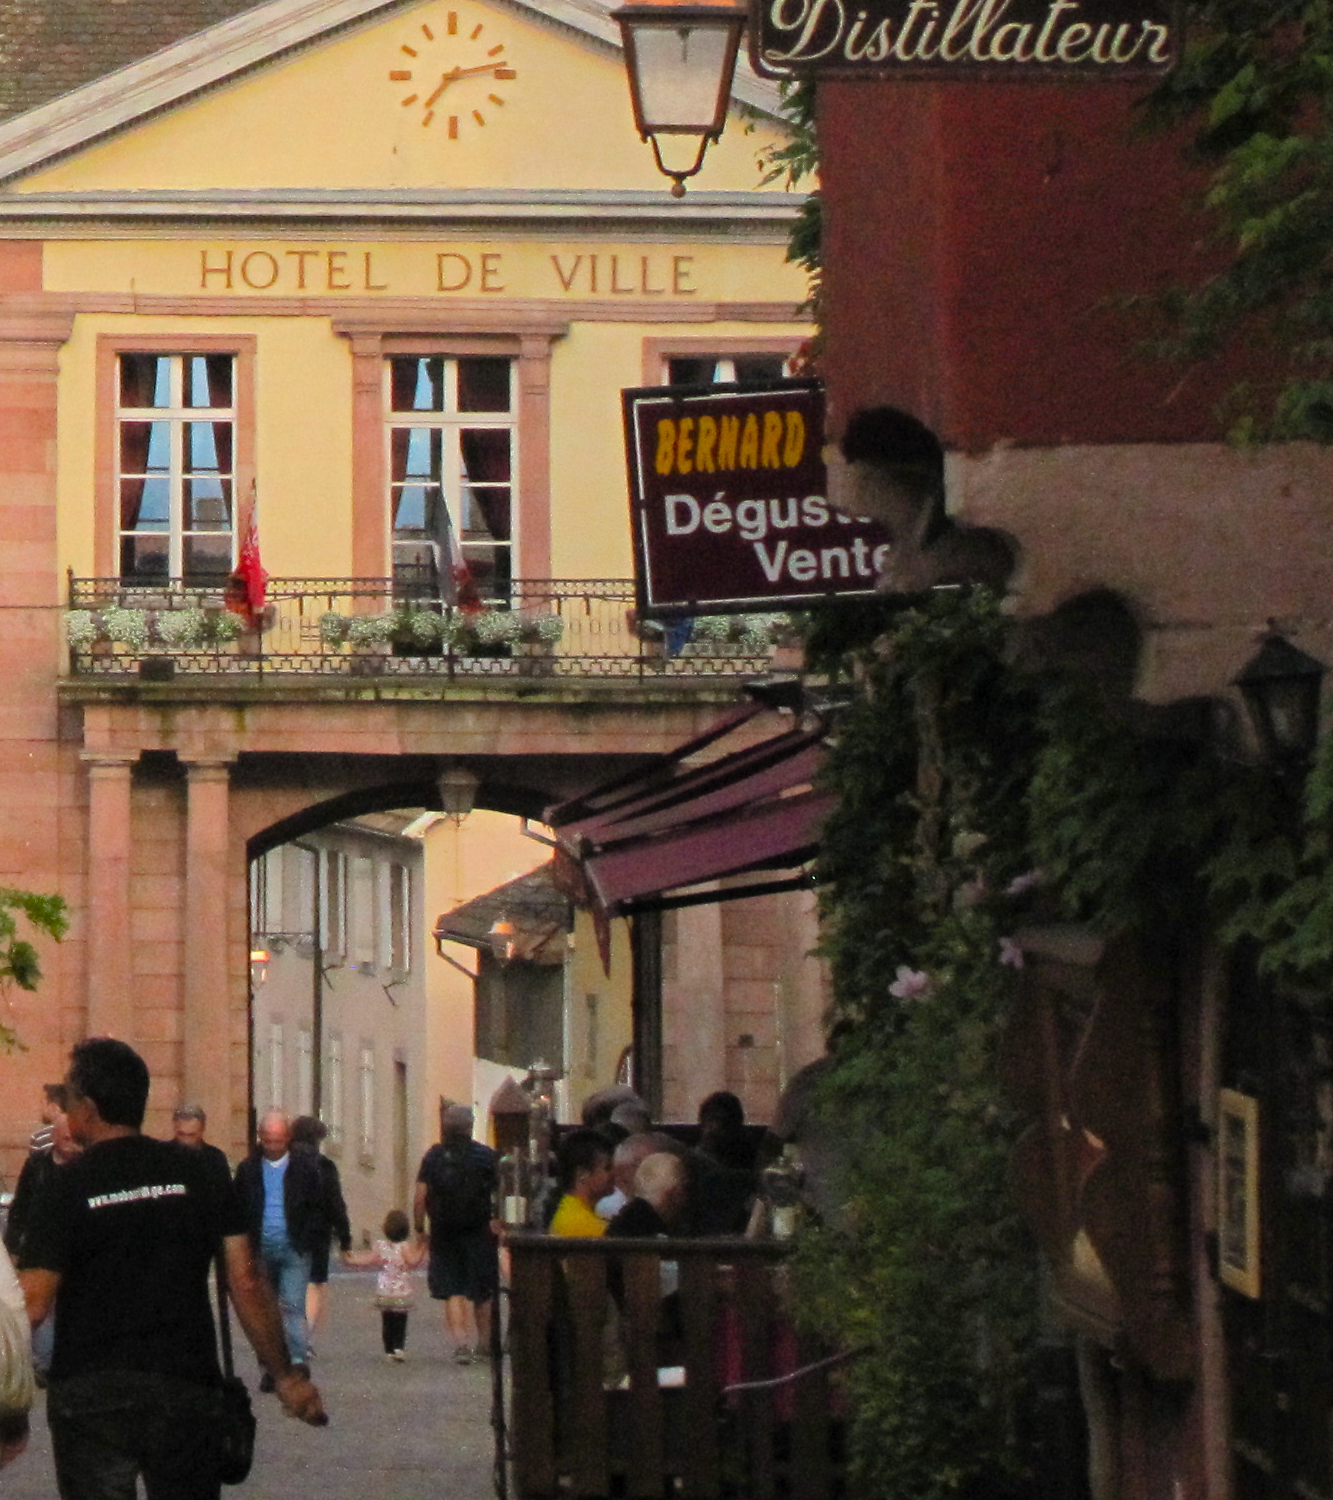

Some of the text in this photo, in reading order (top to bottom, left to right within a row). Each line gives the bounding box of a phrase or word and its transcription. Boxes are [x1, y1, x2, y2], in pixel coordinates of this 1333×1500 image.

[199, 249, 698, 295] HOTEL DE VILLE
[655, 410, 806, 476] BERNARD
